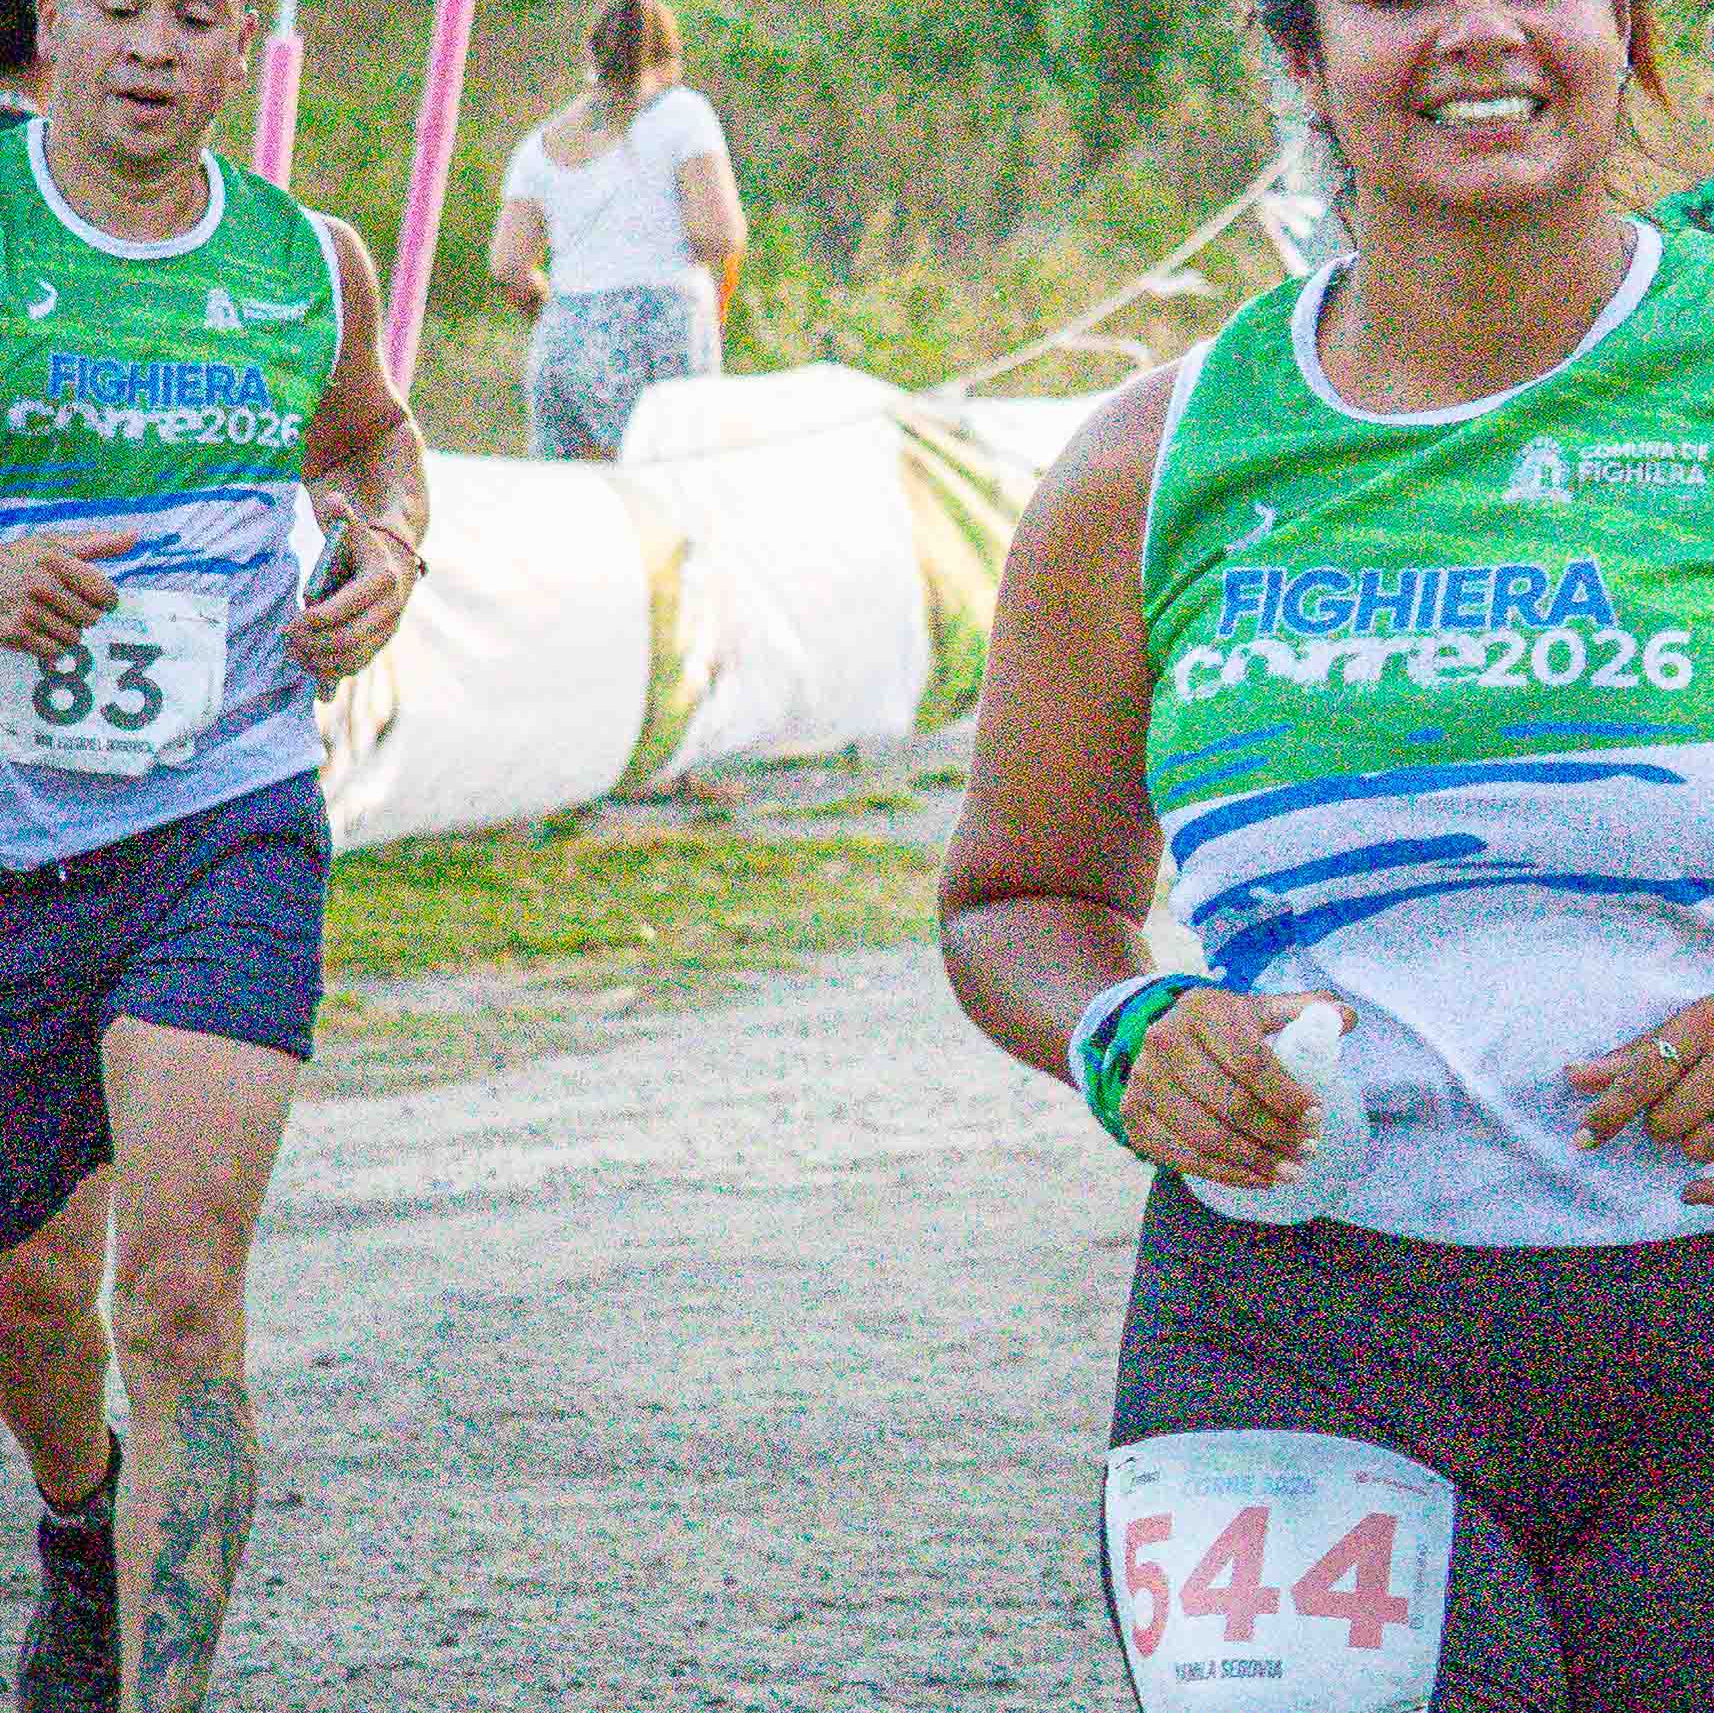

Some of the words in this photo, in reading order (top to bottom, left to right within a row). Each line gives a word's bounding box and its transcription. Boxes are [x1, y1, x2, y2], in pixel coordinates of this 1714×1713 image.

[50, 354, 271, 408] FIGHIERA
[1578, 460, 1707, 486] FIGHIERA
[1219, 558, 1619, 636] FIGHIERA
[33, 644, 163, 732] 83
[1124, 1506, 1409, 1659] 544
